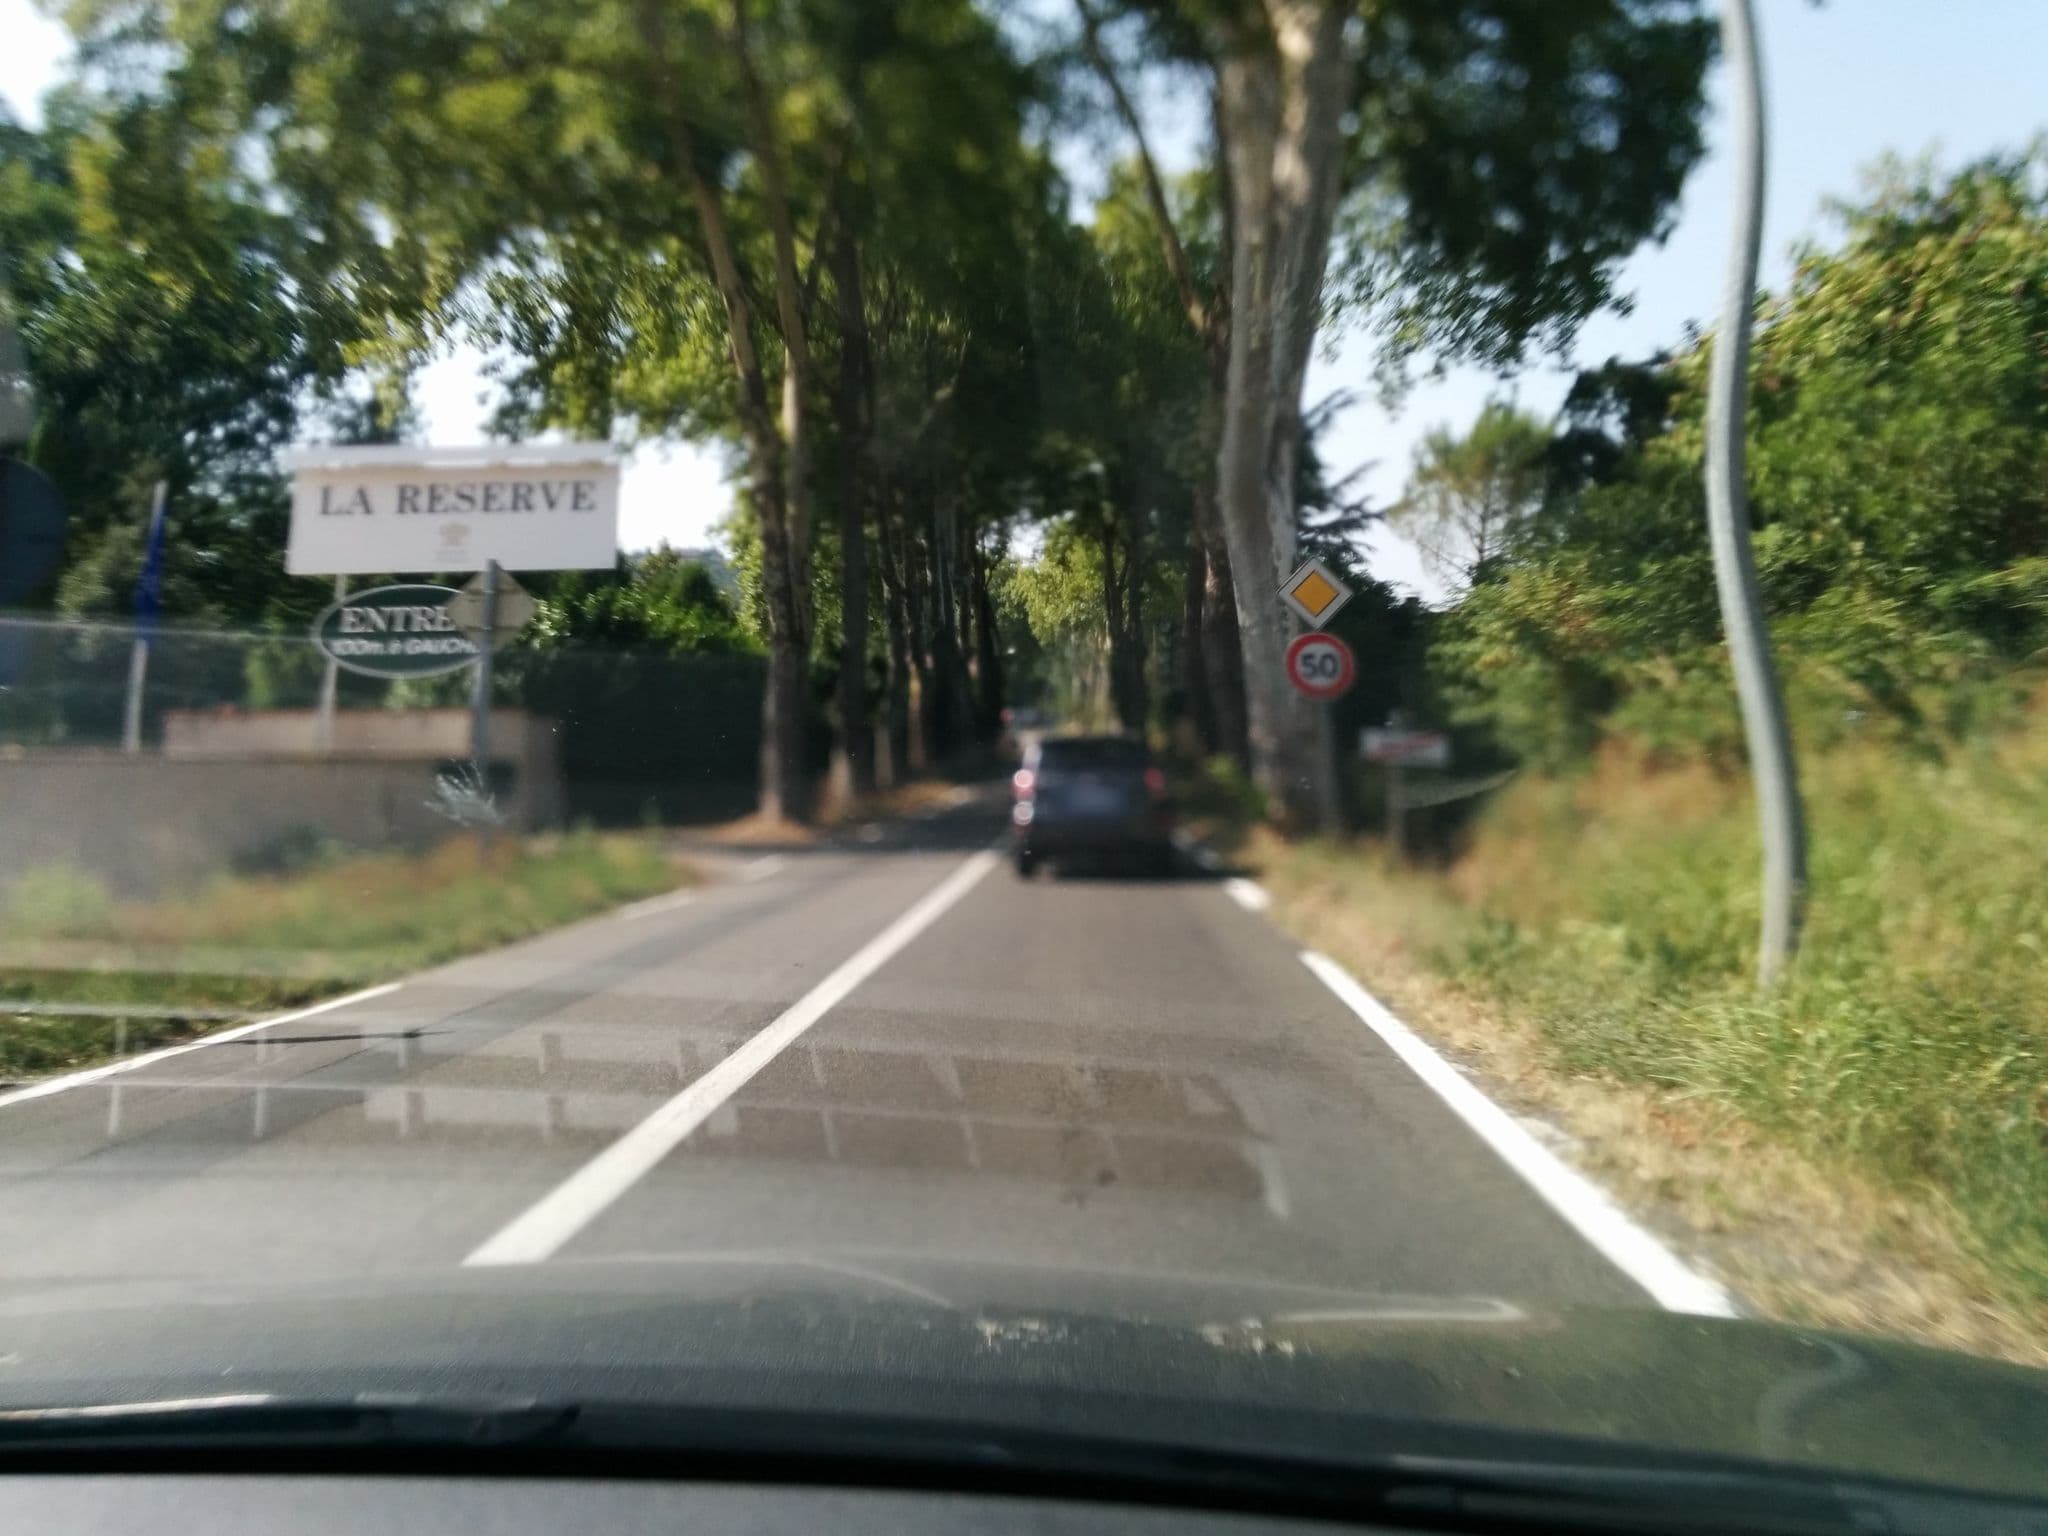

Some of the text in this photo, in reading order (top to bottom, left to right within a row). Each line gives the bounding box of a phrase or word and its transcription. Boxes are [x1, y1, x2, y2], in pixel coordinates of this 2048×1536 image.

[320, 481, 596, 516] LA RESERVE
[340, 606, 456, 633] ENTRE
[1302, 653, 1338, 679] 50
